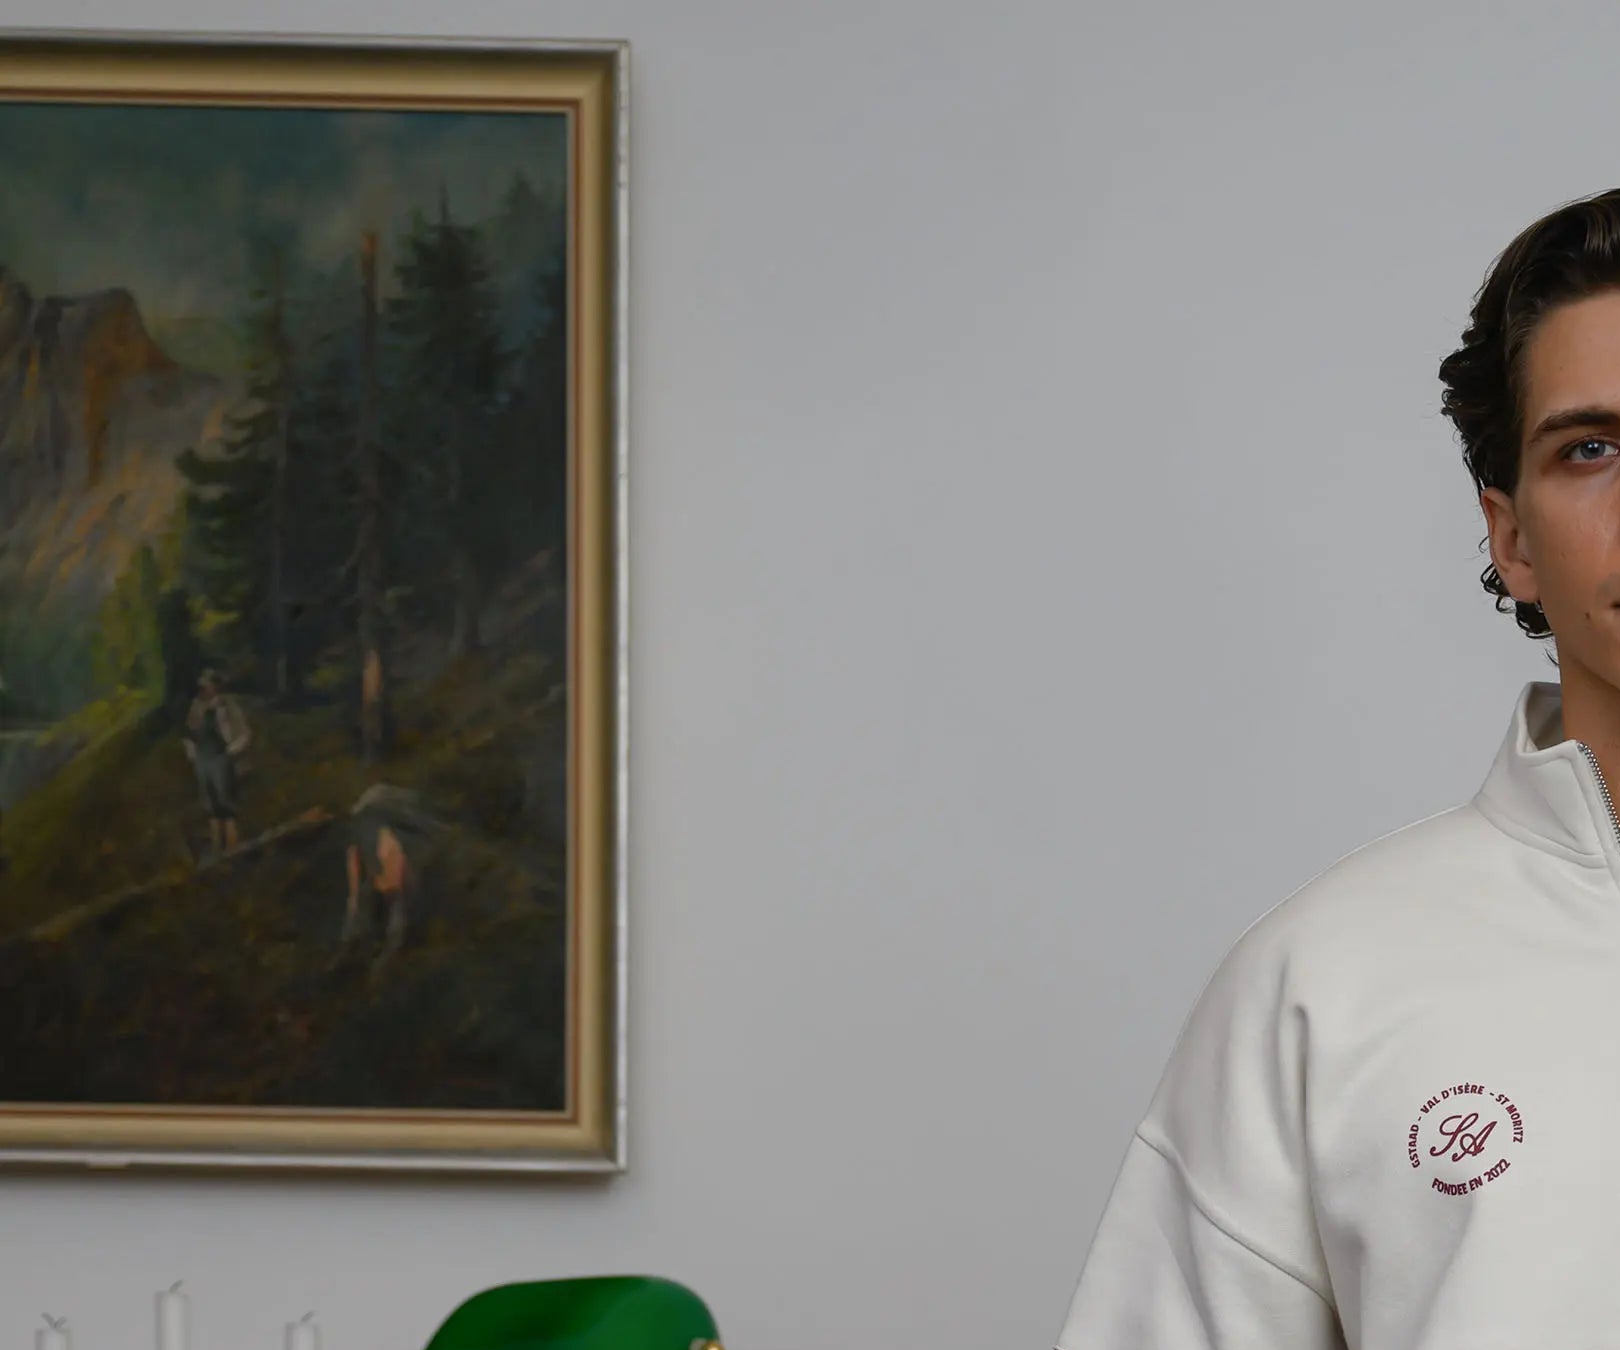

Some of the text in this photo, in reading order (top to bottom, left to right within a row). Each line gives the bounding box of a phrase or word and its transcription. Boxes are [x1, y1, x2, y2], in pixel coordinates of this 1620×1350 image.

[1408, 1124, 1420, 1168] GSTAAD
[1420, 1095, 1441, 1114] VAL
[1441, 1082, 1485, 1100] D'ISÈRE
[1495, 1094, 1510, 1105] ST
[1505, 1104, 1524, 1144] MORITZ
[1431, 1158, 1511, 1196] FONDEE EN 2022
